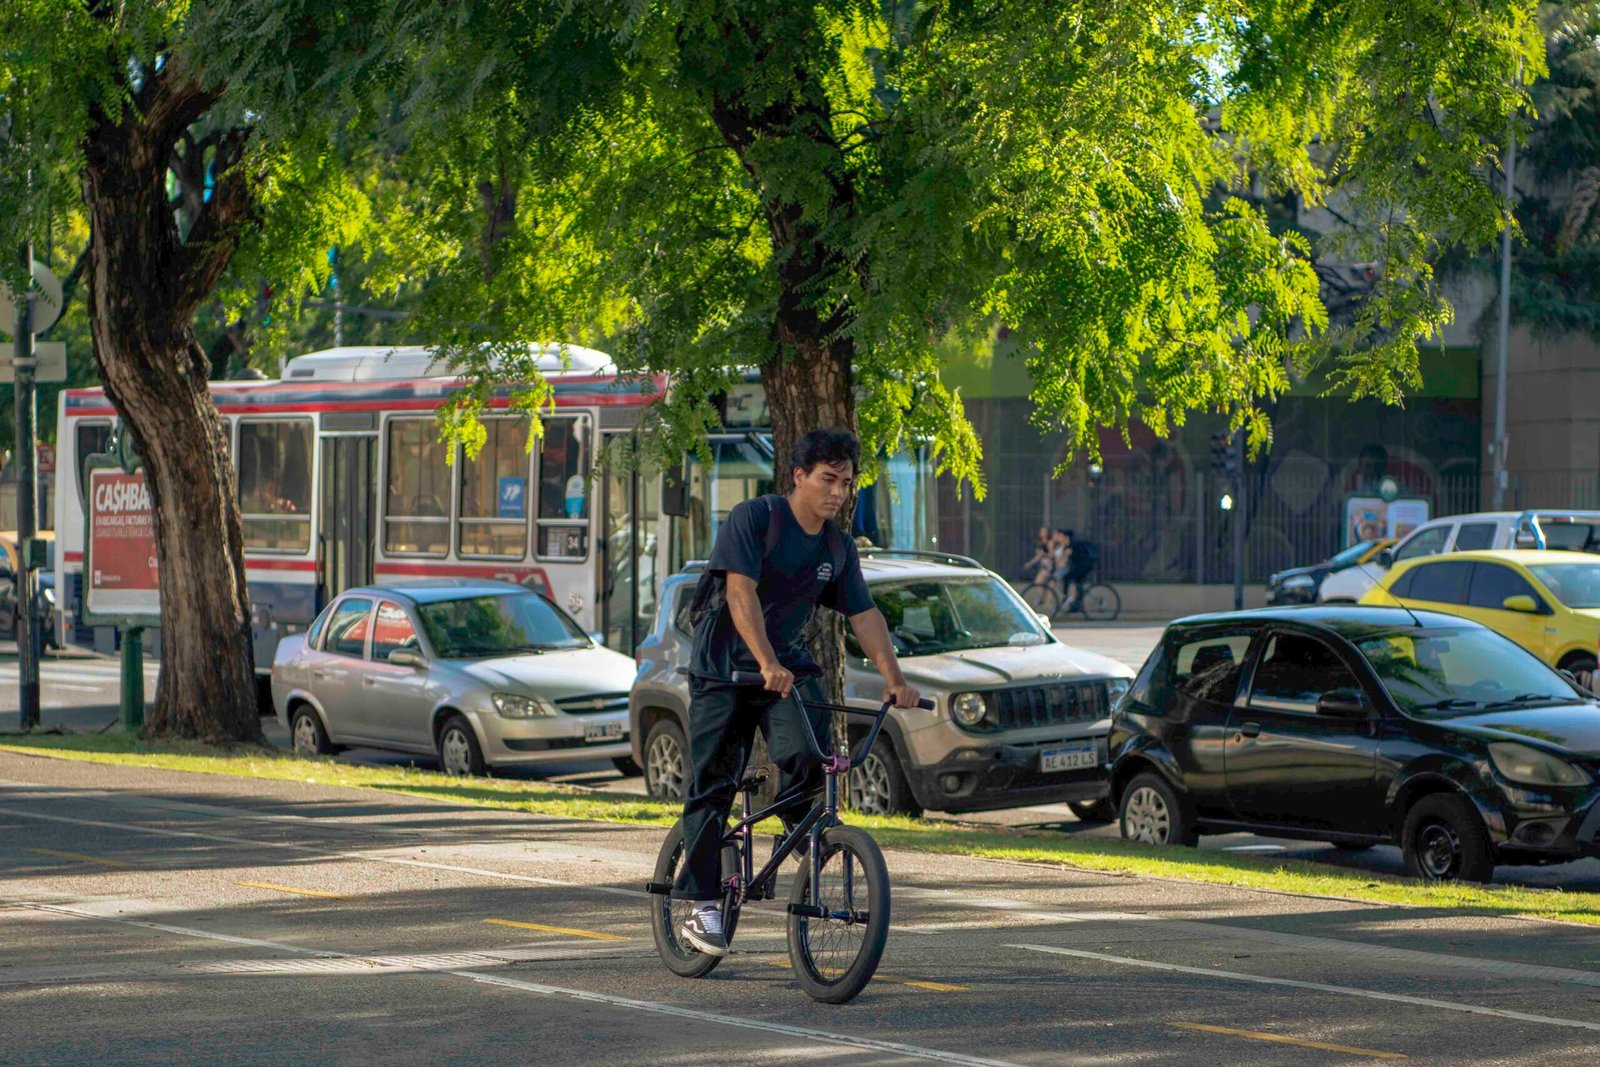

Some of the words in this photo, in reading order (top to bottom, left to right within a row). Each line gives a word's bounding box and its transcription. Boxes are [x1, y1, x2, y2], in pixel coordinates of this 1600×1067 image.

[96, 480, 151, 514] CA$HBA
[567, 536, 578, 548] 34
[1045, 757, 1057, 769] AE
[1060, 754, 1079, 768] 412
